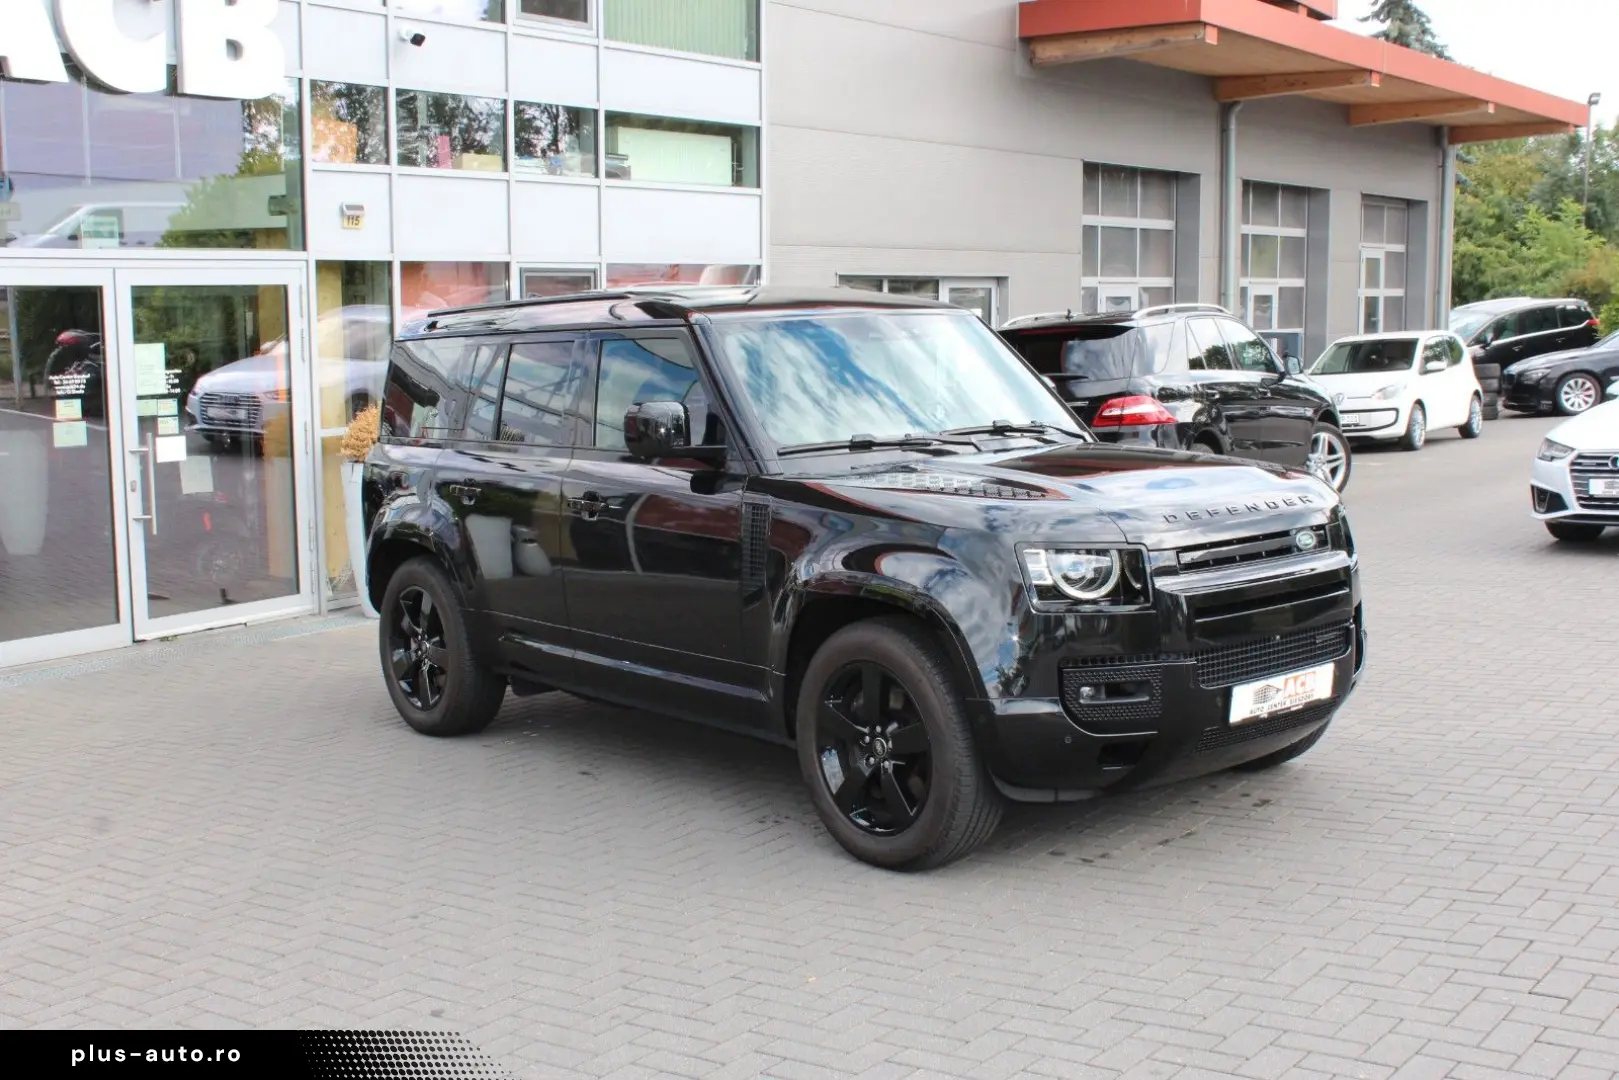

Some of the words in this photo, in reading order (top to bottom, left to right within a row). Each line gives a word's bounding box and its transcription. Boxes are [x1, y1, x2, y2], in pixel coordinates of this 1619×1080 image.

[347, 215, 361, 226] 115
[1162, 494, 1315, 524] DEFENDER
[1250, 706, 1265, 715] AUTO
